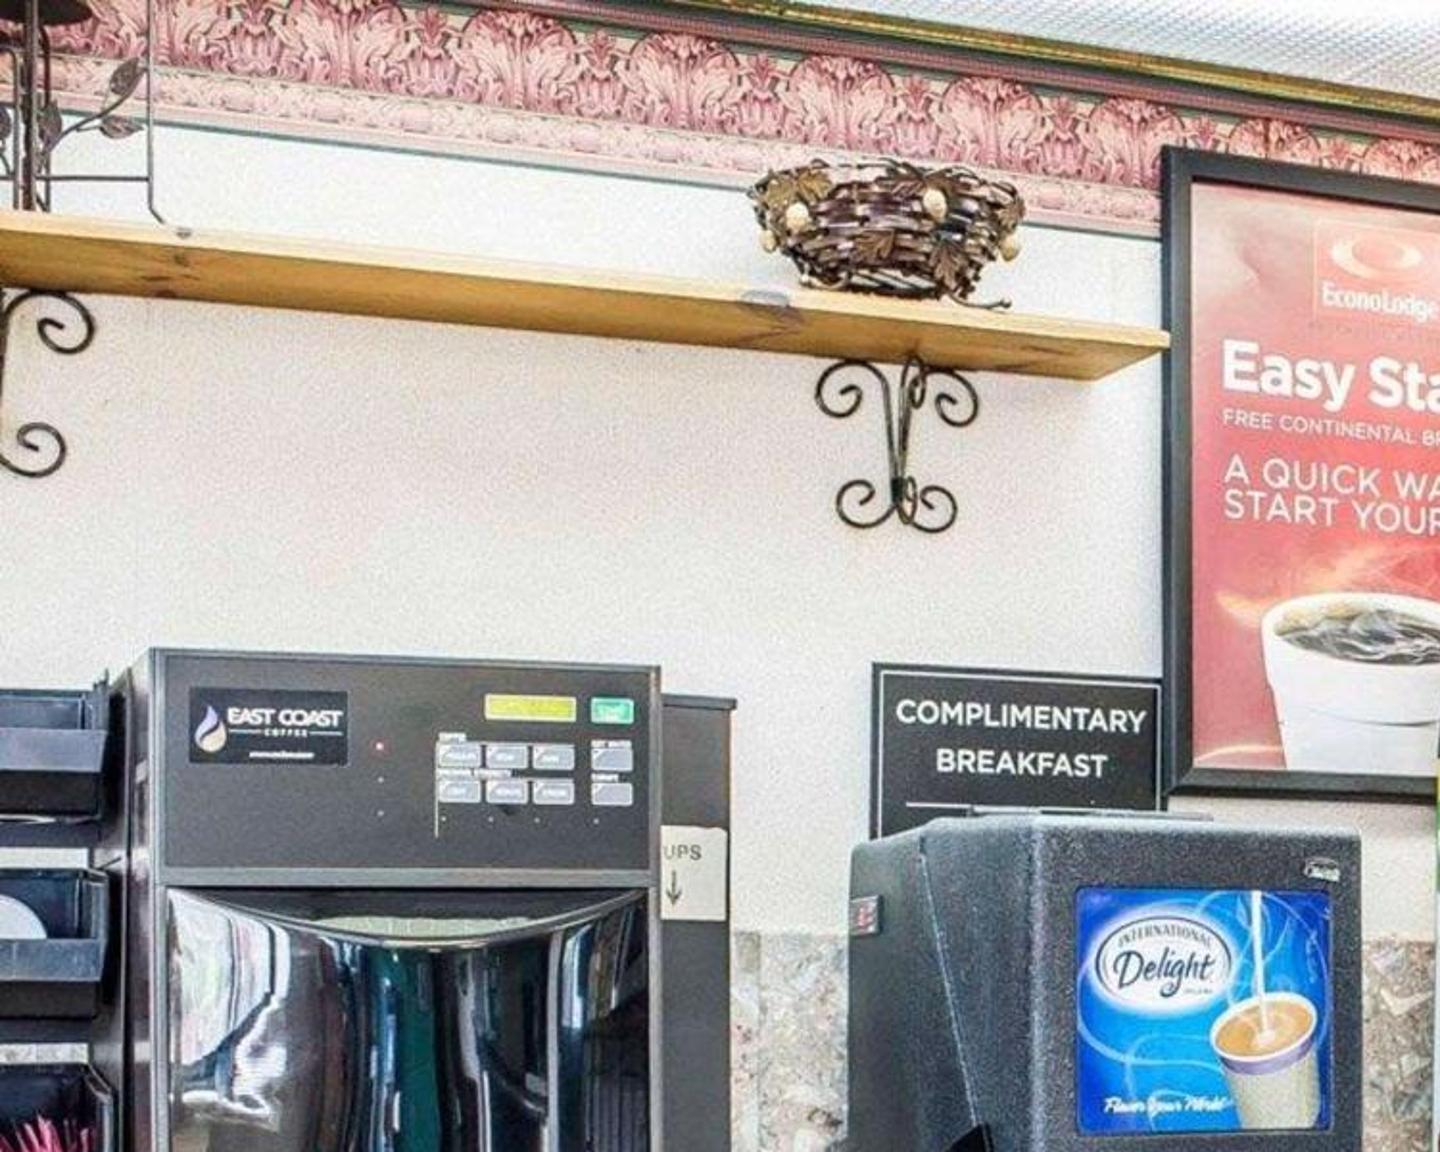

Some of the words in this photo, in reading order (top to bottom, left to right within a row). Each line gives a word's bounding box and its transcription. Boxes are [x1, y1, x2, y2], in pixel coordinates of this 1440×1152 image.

[1222, 339, 1356, 412] Easy
[1222, 408, 1273, 429] FREE
[1279, 415, 1416, 446] CONTINENTAL
[1224, 454, 1250, 485] A
[1263, 457, 1381, 498] QUICK
[1224, 489, 1338, 527] START
[227, 706, 276, 725] EAST
[278, 708, 344, 728] COAST
[896, 698, 1147, 734] COMPLIMENTARY
[936, 747, 1109, 779] BREAKFAST
[663, 843, 702, 861] UPS
[1117, 924, 1213, 950] INTERNATIONAL
[1112, 946, 1216, 998] Delight
